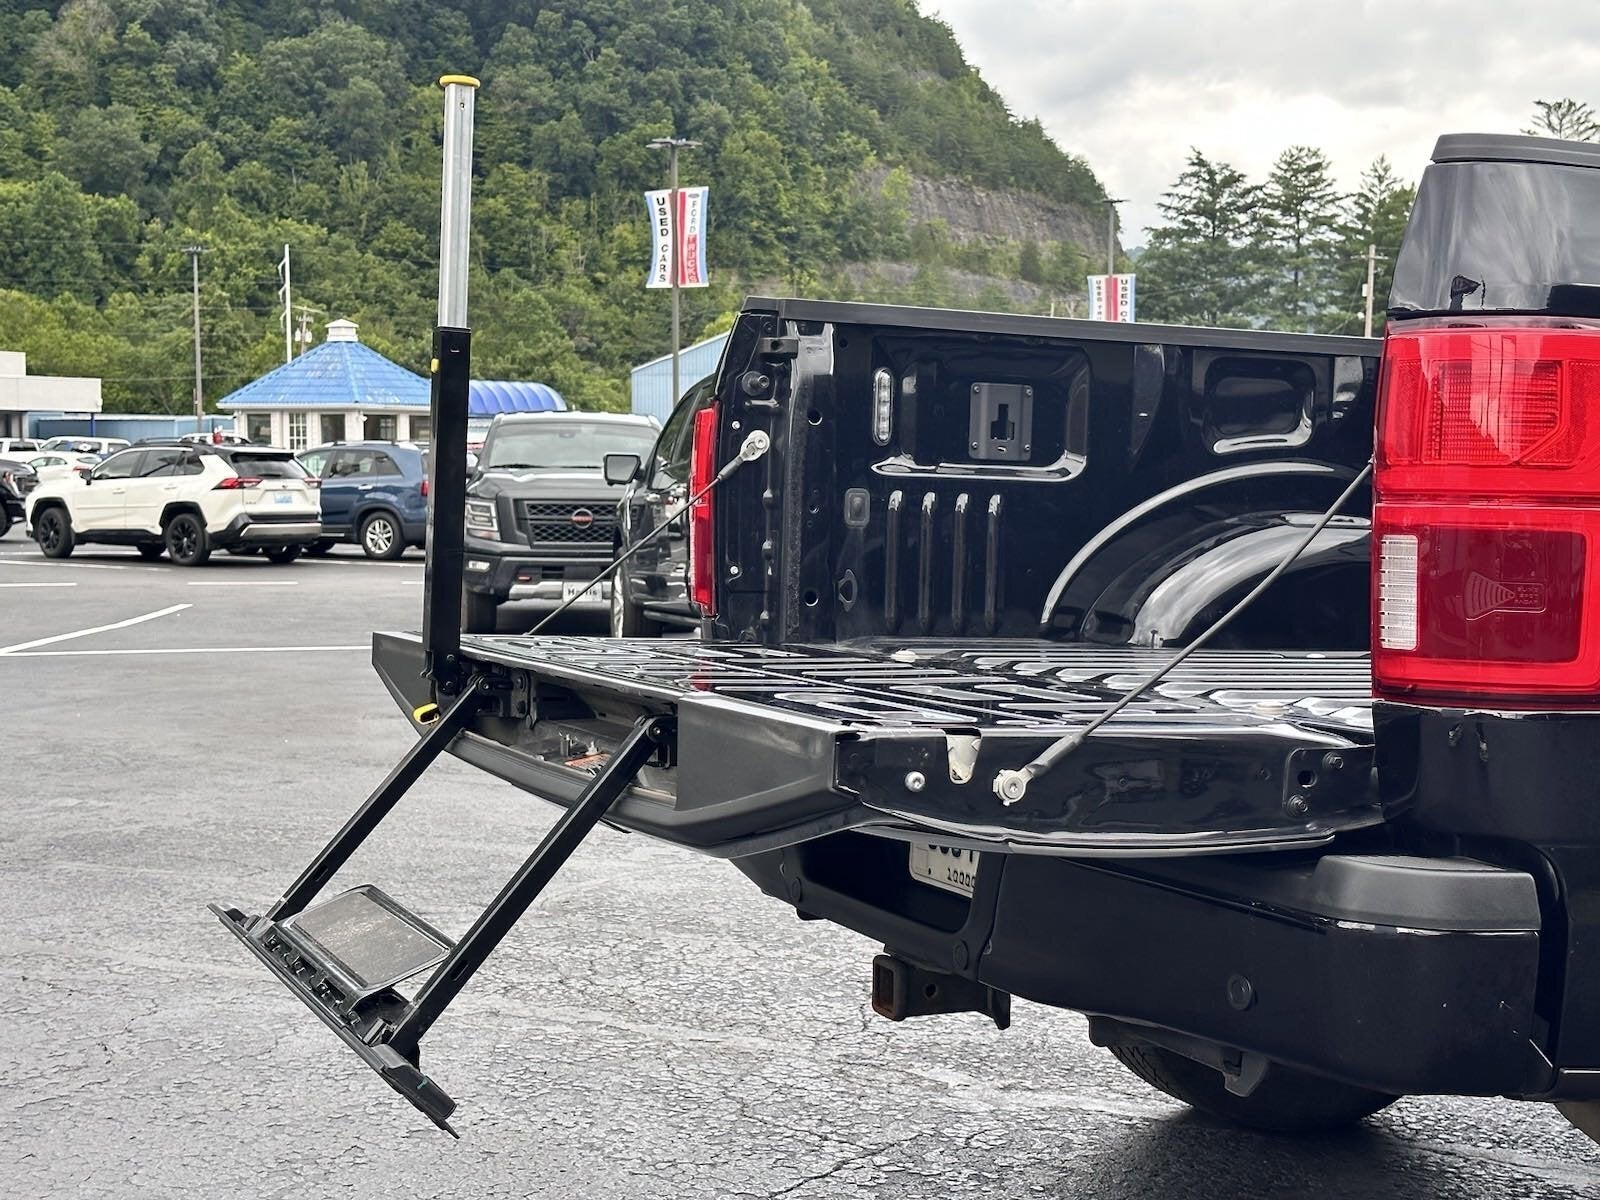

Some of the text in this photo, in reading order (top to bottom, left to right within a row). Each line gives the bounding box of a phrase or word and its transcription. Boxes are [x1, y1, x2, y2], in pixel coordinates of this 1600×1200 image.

[657, 197, 669, 282] USED CARS
[689, 201, 697, 233] FORD
